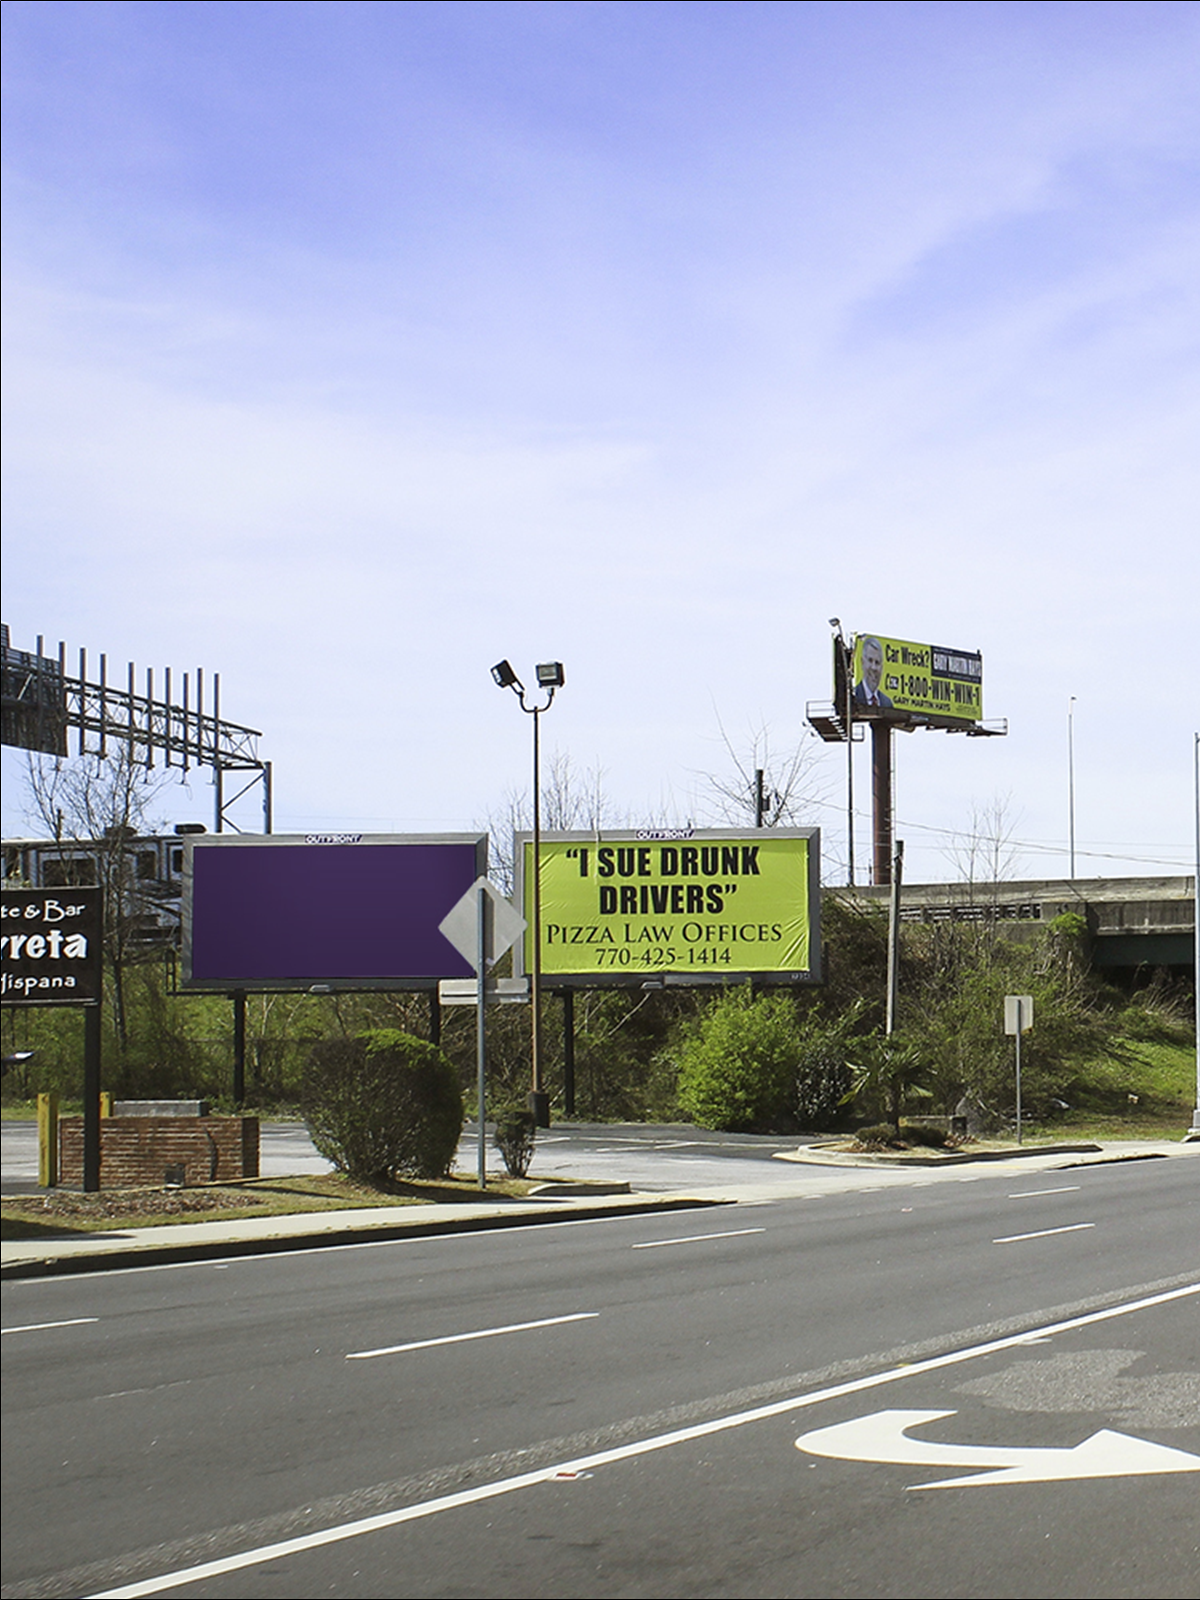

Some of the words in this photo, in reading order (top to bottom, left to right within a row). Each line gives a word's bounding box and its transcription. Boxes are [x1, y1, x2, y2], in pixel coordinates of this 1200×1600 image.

[885, 644, 899, 663] Car
[901, 646, 930, 668] Wreck?
[901, 674, 980, 706] 1-800-WIN-WIN-1
[598, 847, 652, 877] SUE
[660, 846, 760, 876] DRUNK
[24, 904, 40, 919] &
[42, 899, 85, 922] Bar
[547, 924, 614, 944] PIZZA
[624, 923, 674, 943] LAW
[682, 922, 782, 943] OFFICES
[595, 948, 731, 966] 770-425-1414
